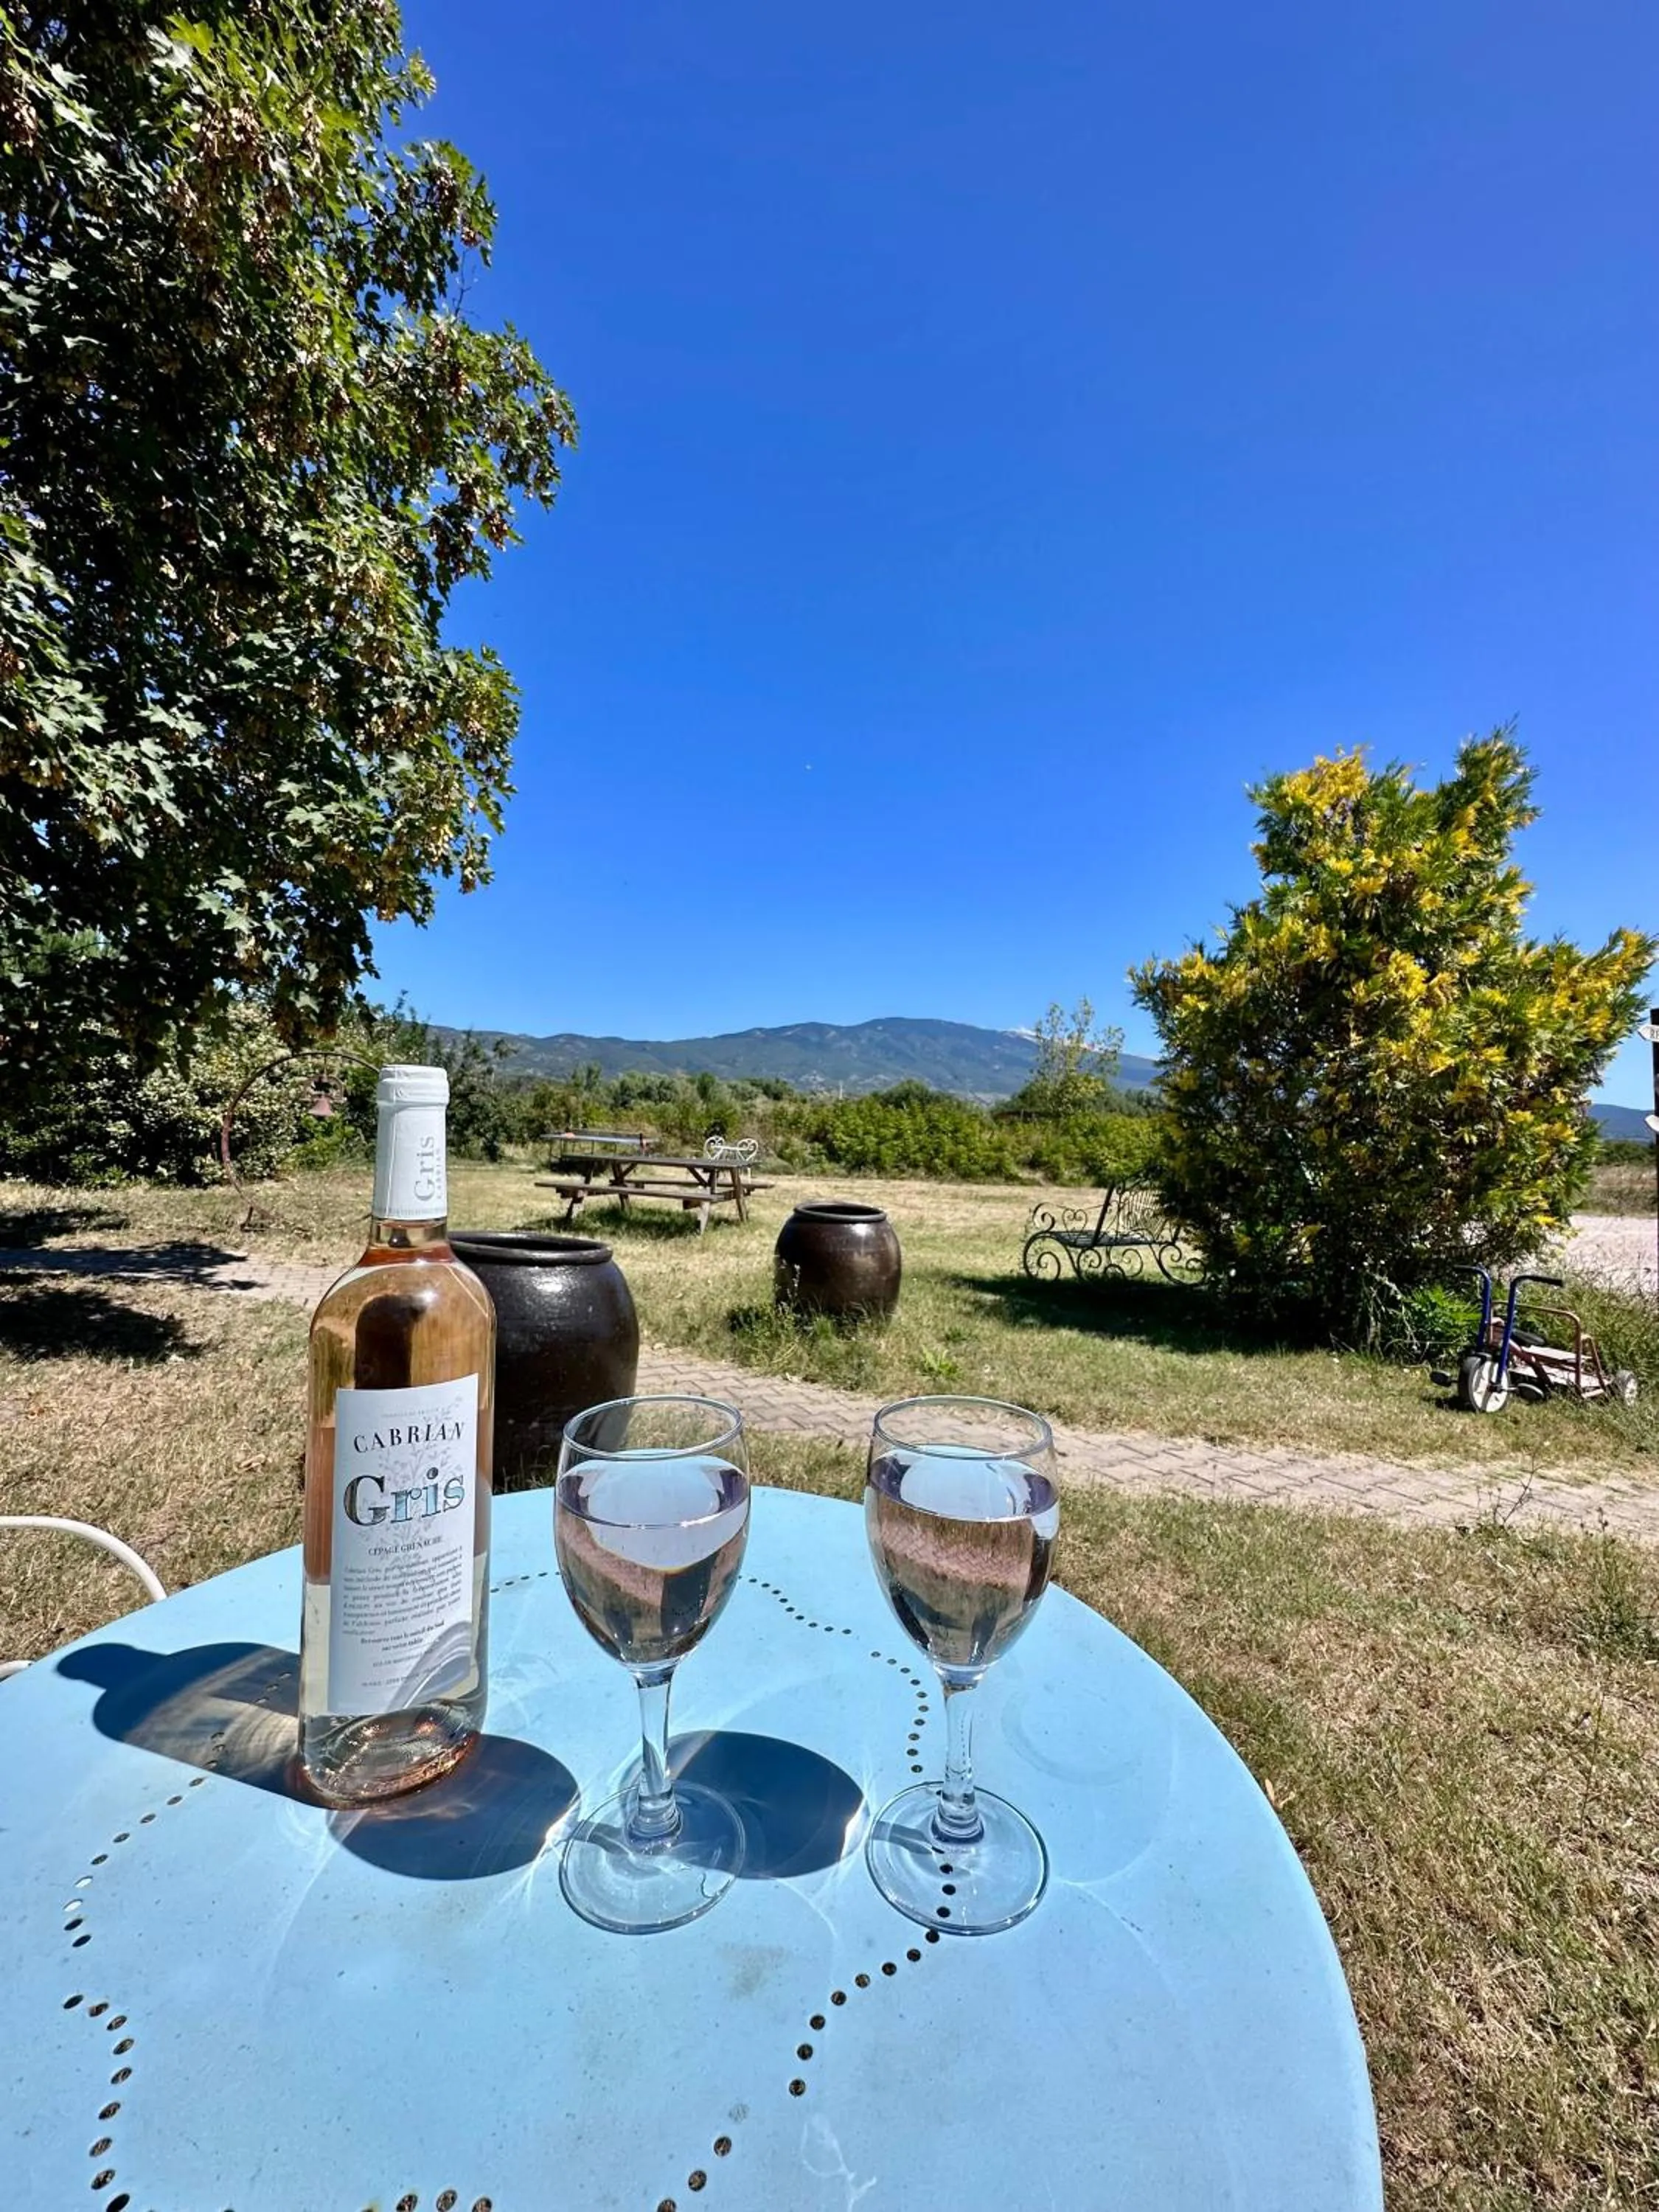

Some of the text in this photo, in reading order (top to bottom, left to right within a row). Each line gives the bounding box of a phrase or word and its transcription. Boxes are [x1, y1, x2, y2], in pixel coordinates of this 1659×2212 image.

[414, 1136, 435, 1201] Gris
[353, 1422, 465, 1453] CABRIAN
[344, 1467, 465, 1527] Gris
